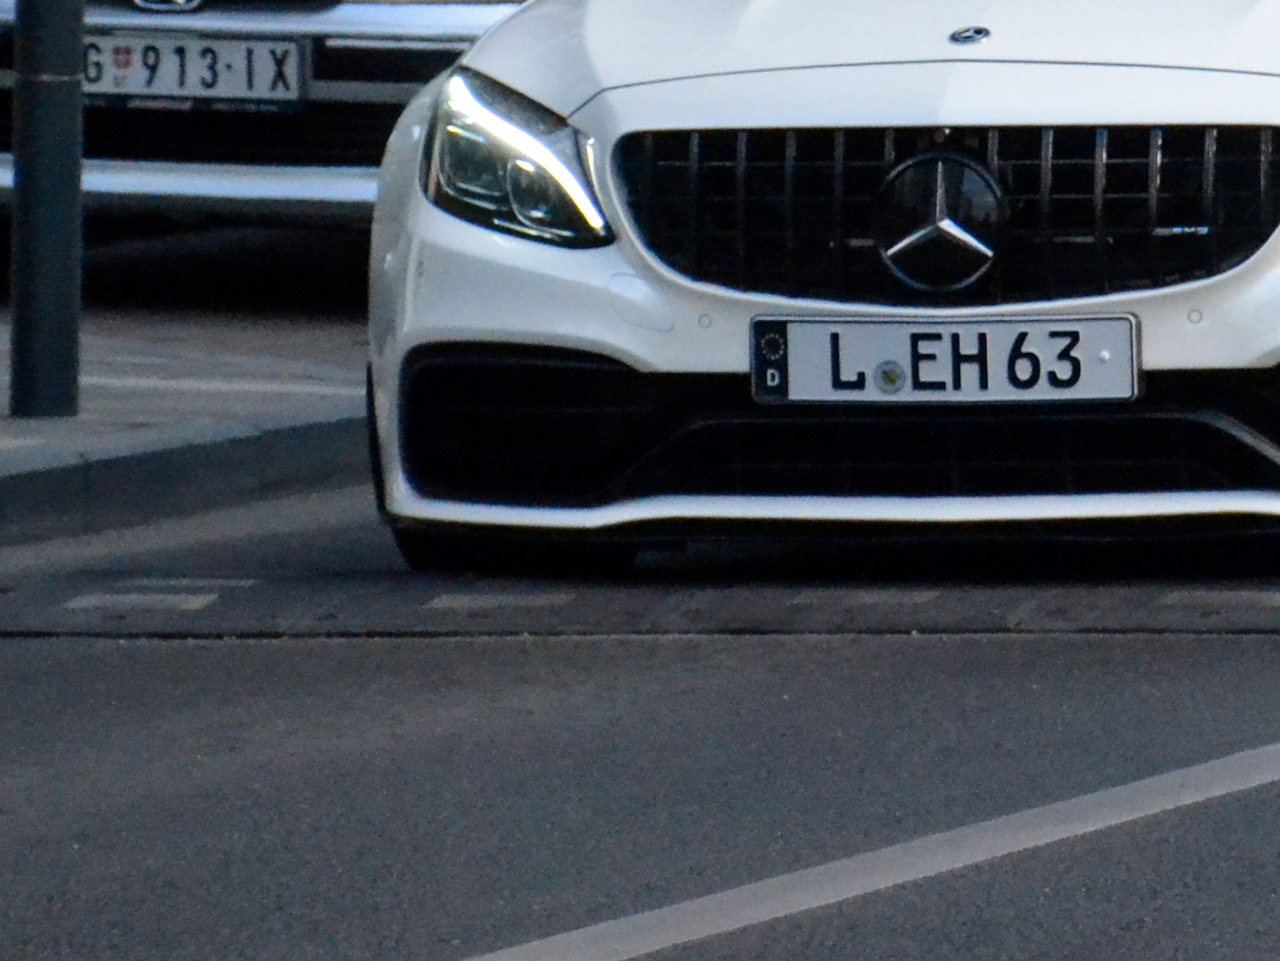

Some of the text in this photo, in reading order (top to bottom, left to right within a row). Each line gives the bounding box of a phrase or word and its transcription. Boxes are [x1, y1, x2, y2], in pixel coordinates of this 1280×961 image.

[83, 43, 103, 84] G
[766, 368, 780, 386] D
[830, 330, 1081, 391] L EH 63
